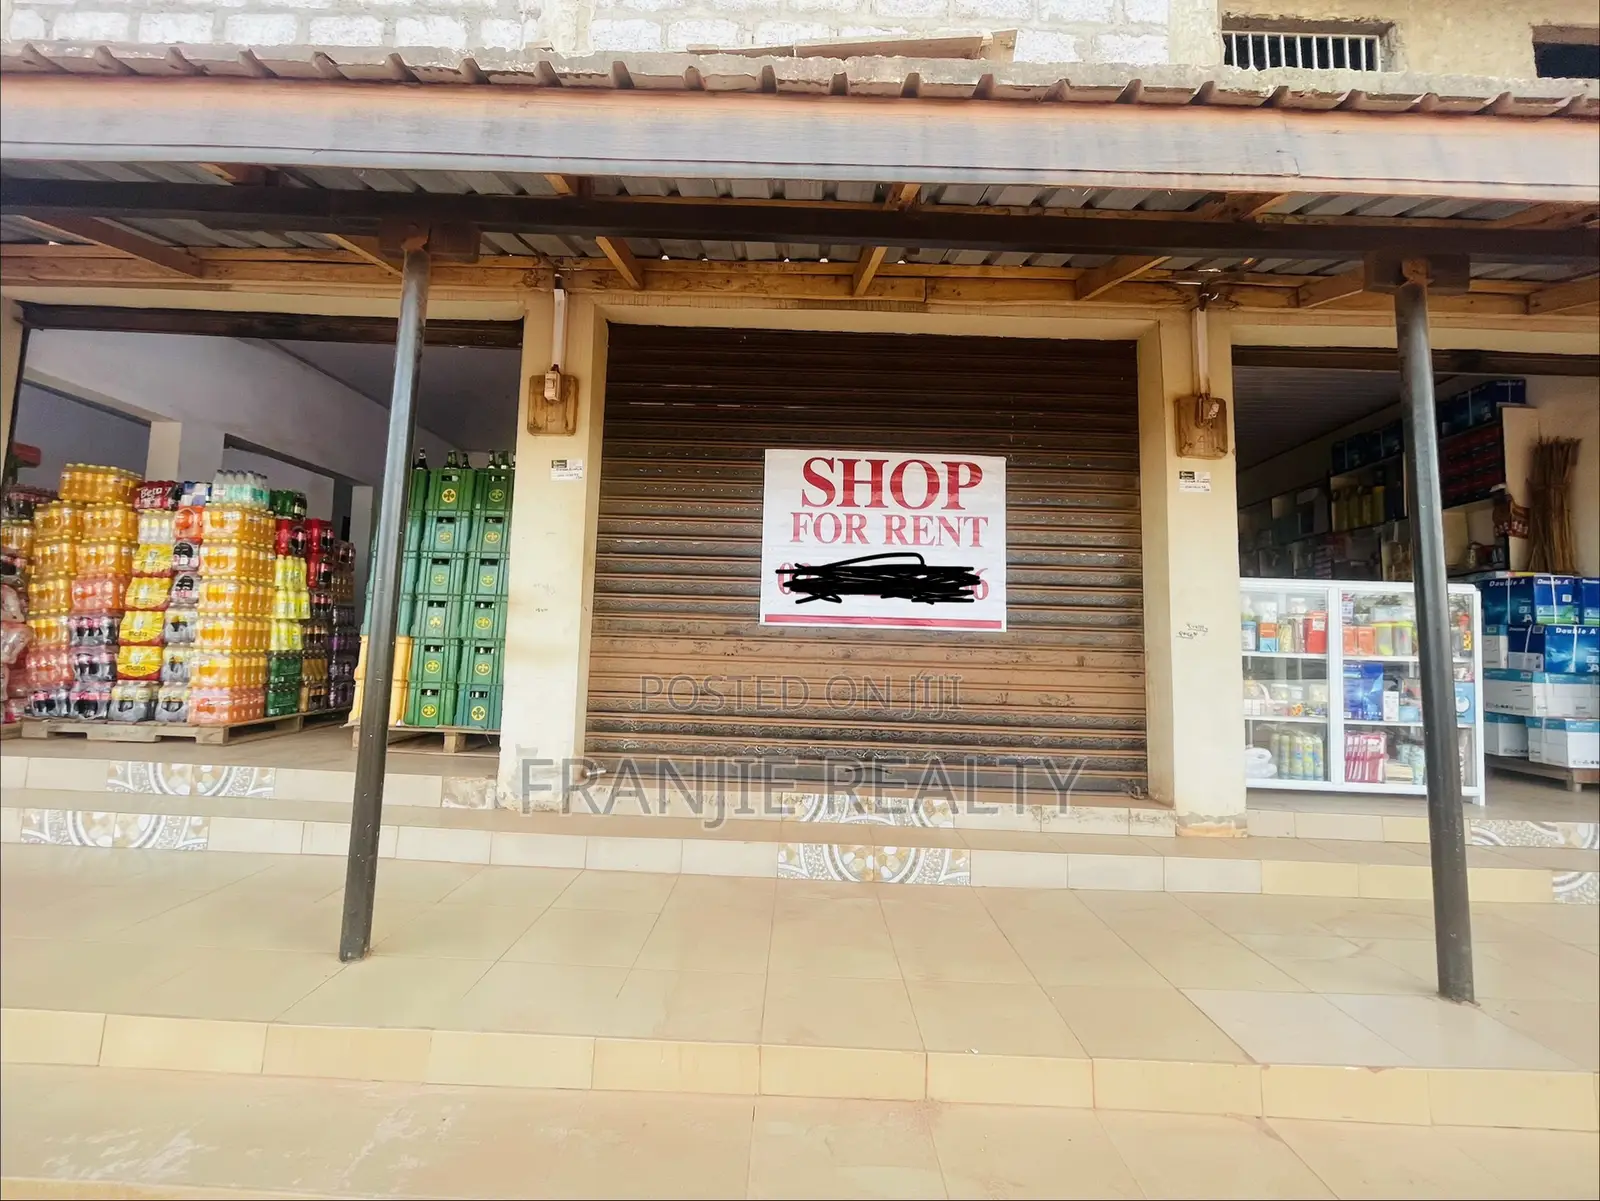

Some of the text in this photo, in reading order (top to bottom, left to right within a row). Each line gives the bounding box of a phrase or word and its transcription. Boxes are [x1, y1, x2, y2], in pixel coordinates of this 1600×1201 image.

[801, 456, 983, 510] SHOP
[789, 511, 989, 548] FOR RENT
